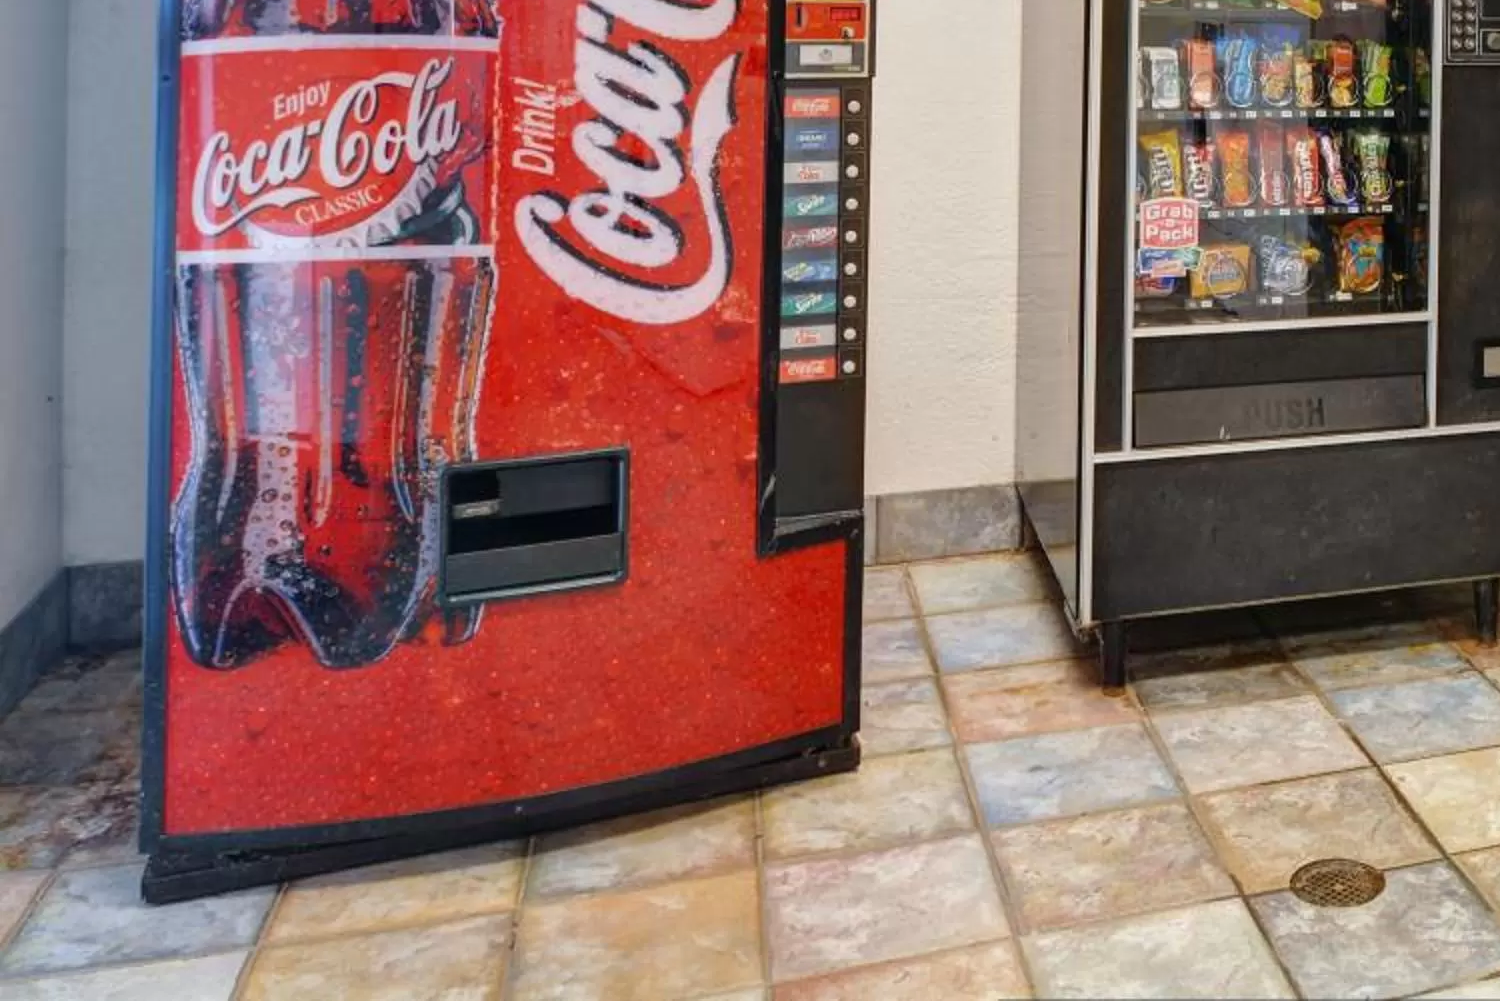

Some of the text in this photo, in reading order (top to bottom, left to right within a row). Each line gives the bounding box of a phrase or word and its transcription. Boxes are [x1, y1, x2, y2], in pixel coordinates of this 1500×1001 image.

[273, 80, 331, 120] Enjoy
[191, 56, 462, 237] Coca-Cola
[511, 76, 557, 176] Drink!
[294, 182, 384, 229] CLASSIC
[1145, 204, 1193, 220] Grab
[1145, 223, 1193, 242] Pack
